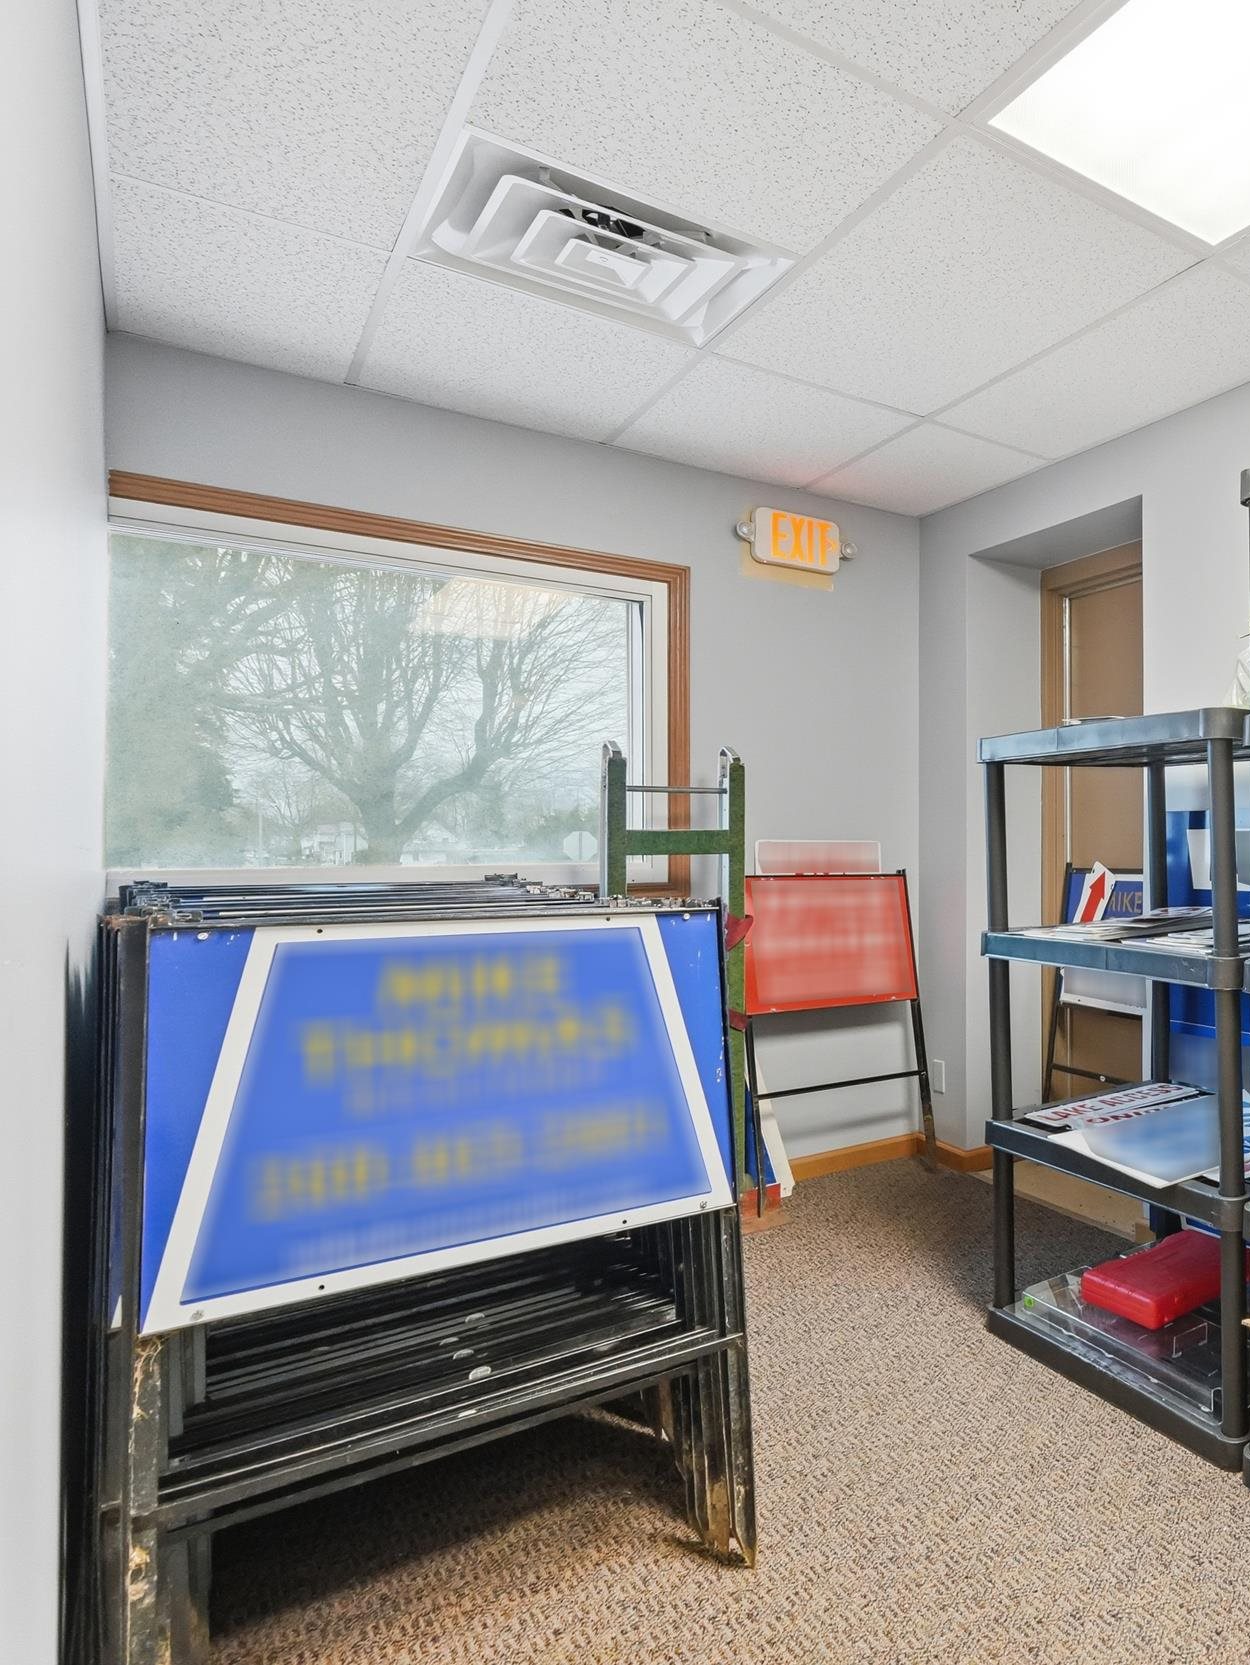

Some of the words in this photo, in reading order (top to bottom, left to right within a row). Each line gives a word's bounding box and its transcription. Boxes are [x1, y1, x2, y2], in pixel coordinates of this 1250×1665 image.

[771, 511, 833, 566] EXIT
[1039, 1101, 1103, 1122] LAKE
[1105, 1083, 1184, 1112] ACCESS
